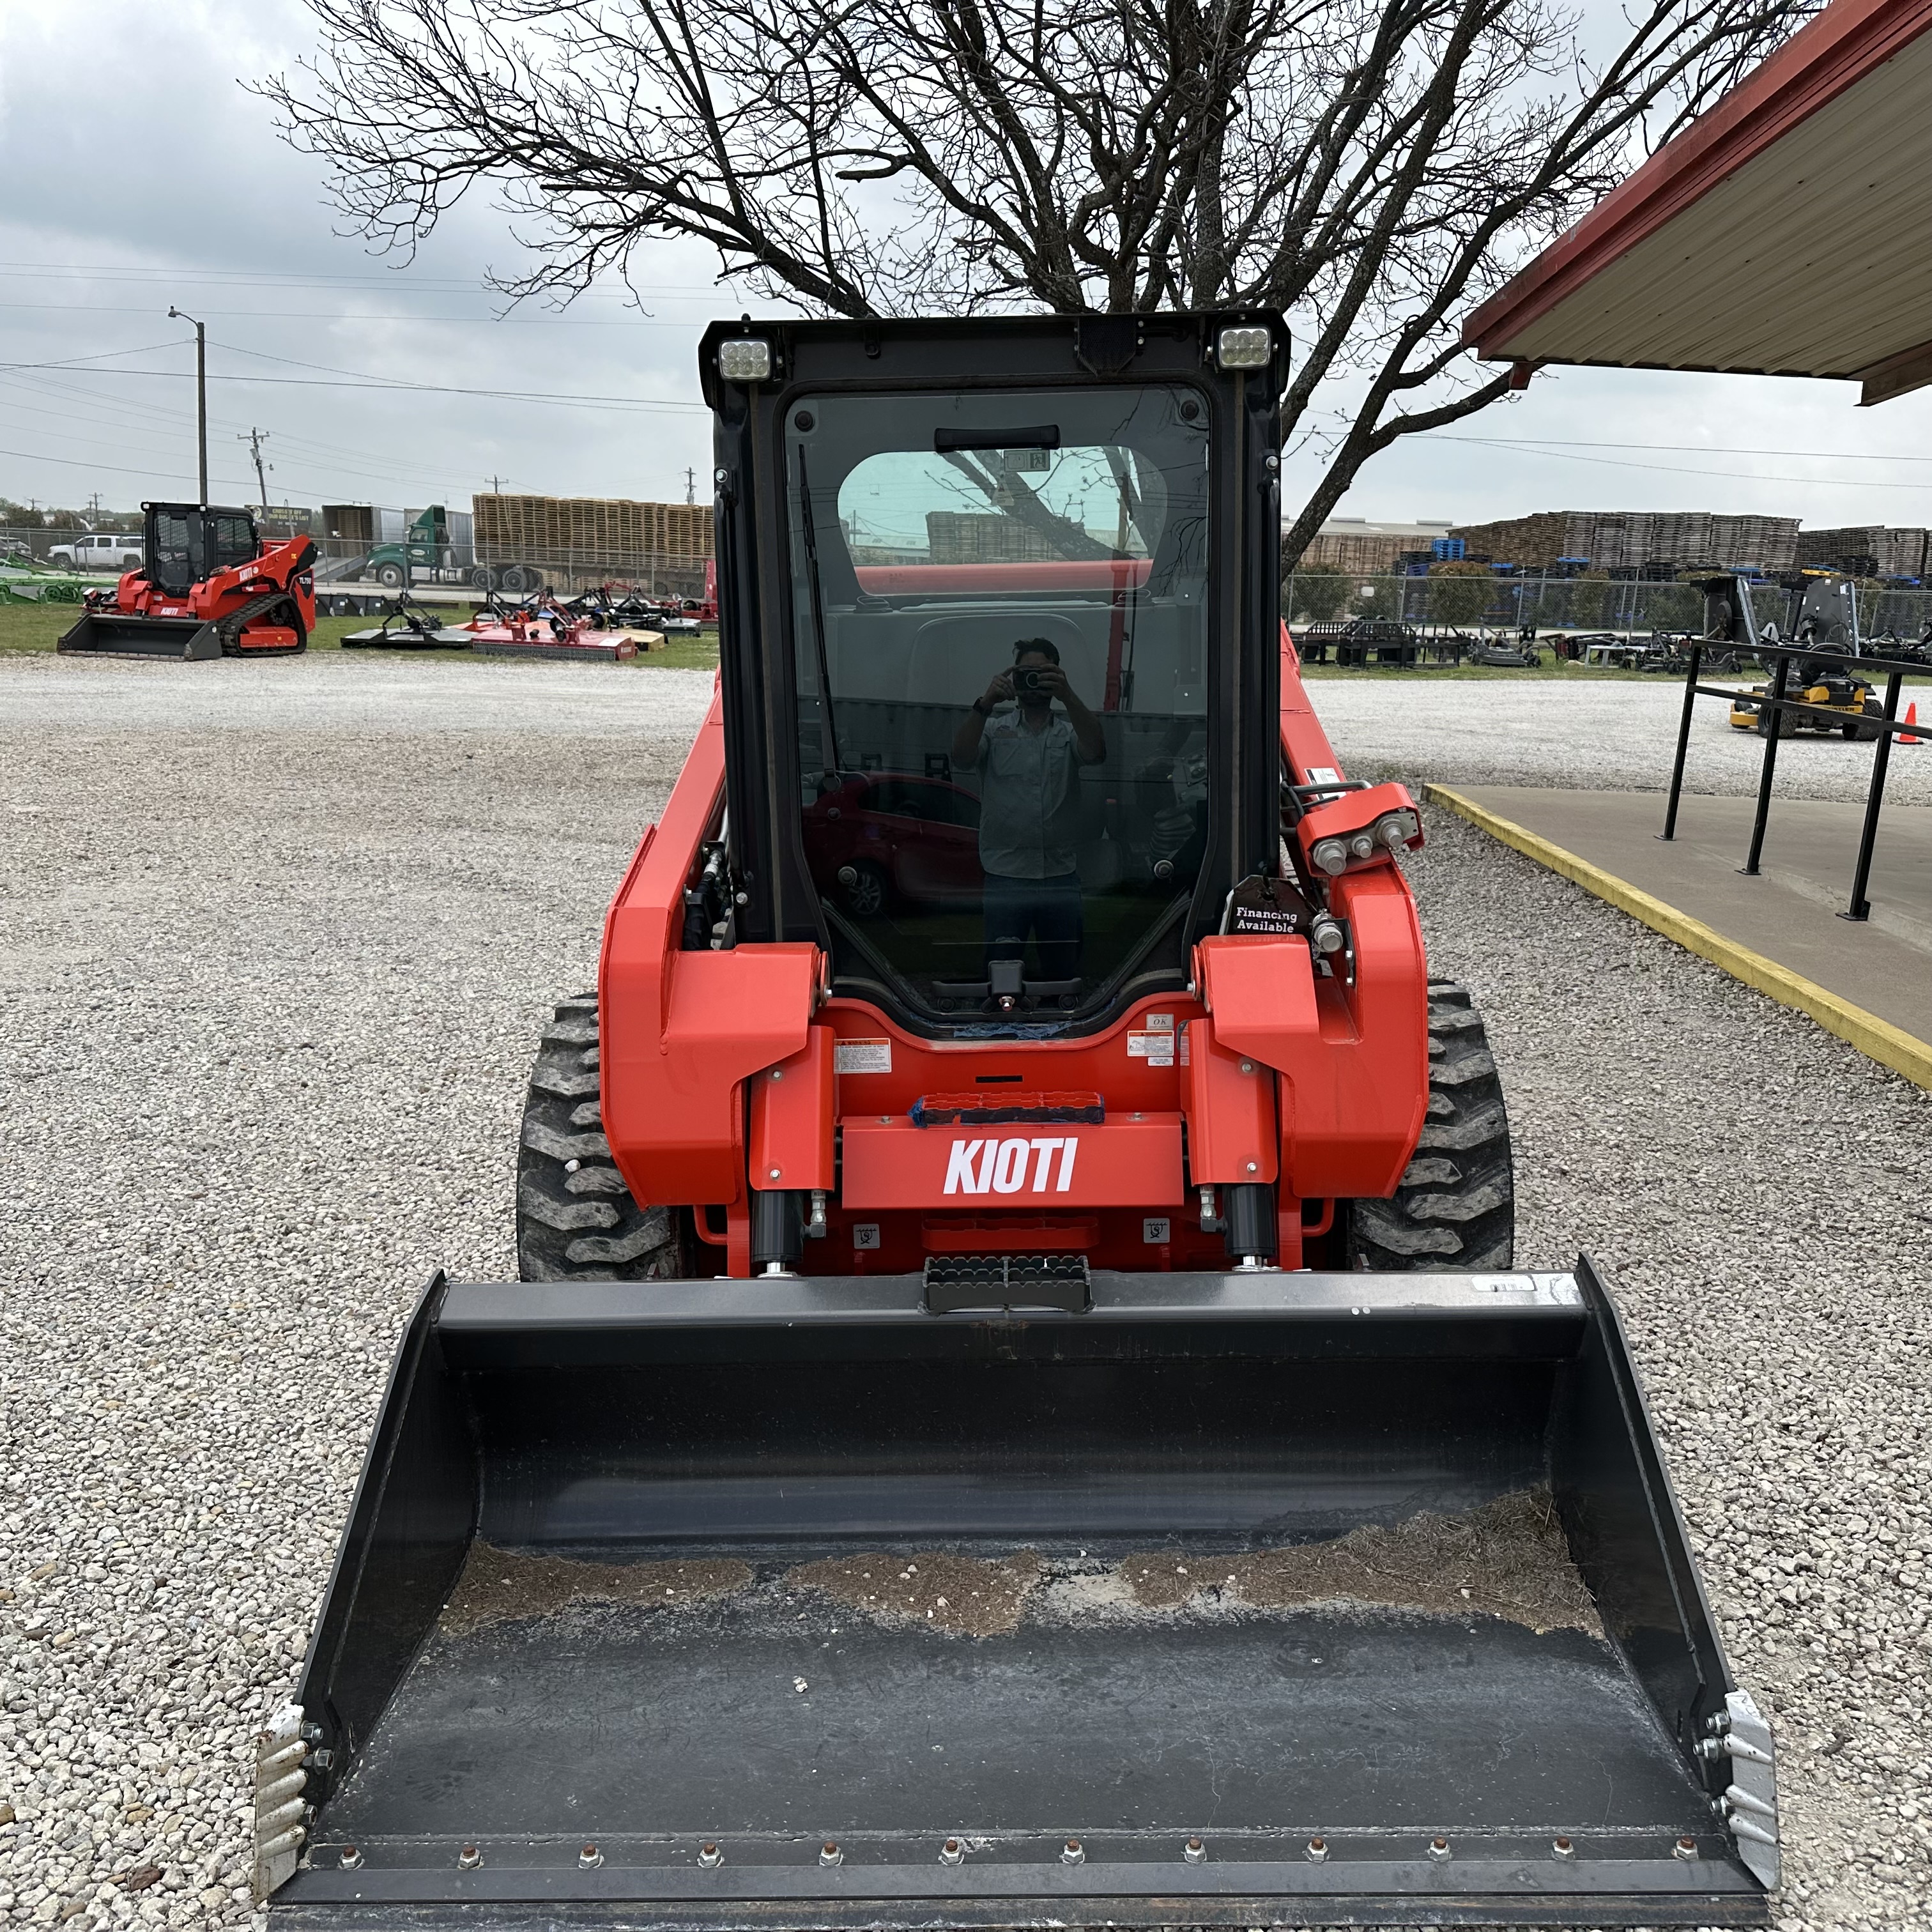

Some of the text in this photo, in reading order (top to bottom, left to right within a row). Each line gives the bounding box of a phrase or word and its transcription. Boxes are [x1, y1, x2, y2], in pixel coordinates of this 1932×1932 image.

[160, 607, 179, 615] KIOTI
[1236, 907, 1298, 923] Financing
[1237, 919, 1294, 933] Available
[943, 1137, 1078, 1194] KIOTI
